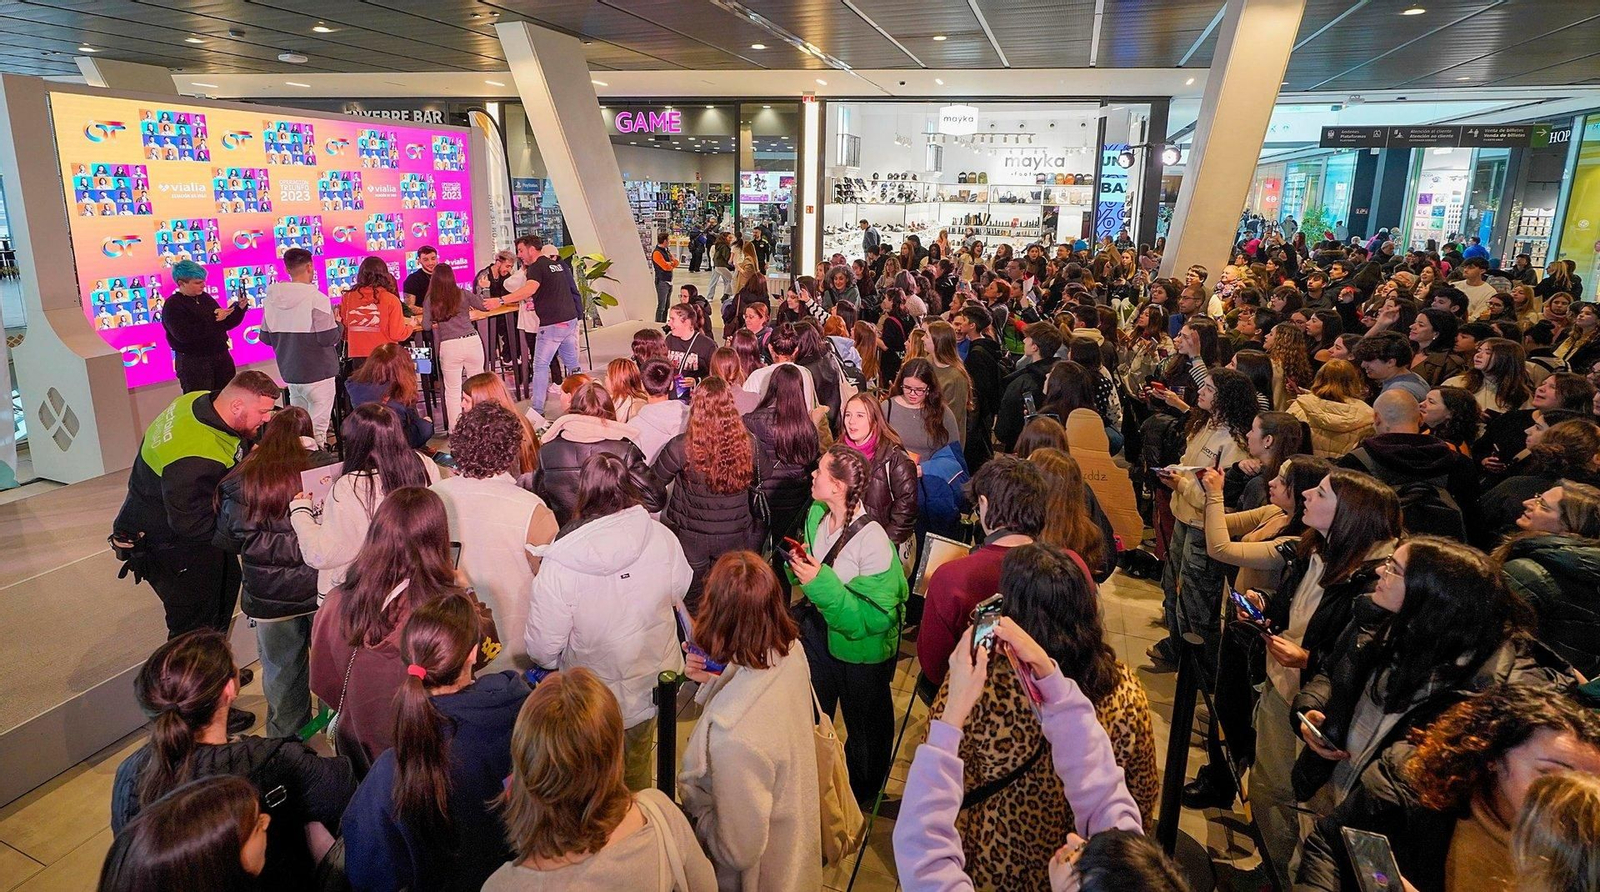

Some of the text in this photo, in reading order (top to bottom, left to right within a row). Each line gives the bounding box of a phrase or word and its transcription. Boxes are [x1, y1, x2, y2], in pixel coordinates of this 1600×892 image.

[344, 110, 443, 123] EBRE BAR
[943, 115, 974, 123] mayka
[615, 111, 682, 133] GAME
[1005, 154, 1065, 171] mayka
[170, 182, 206, 191] vialia
[1101, 182, 1127, 193] BA
[281, 191, 311, 201] 2023
[442, 191, 462, 200] 2023
